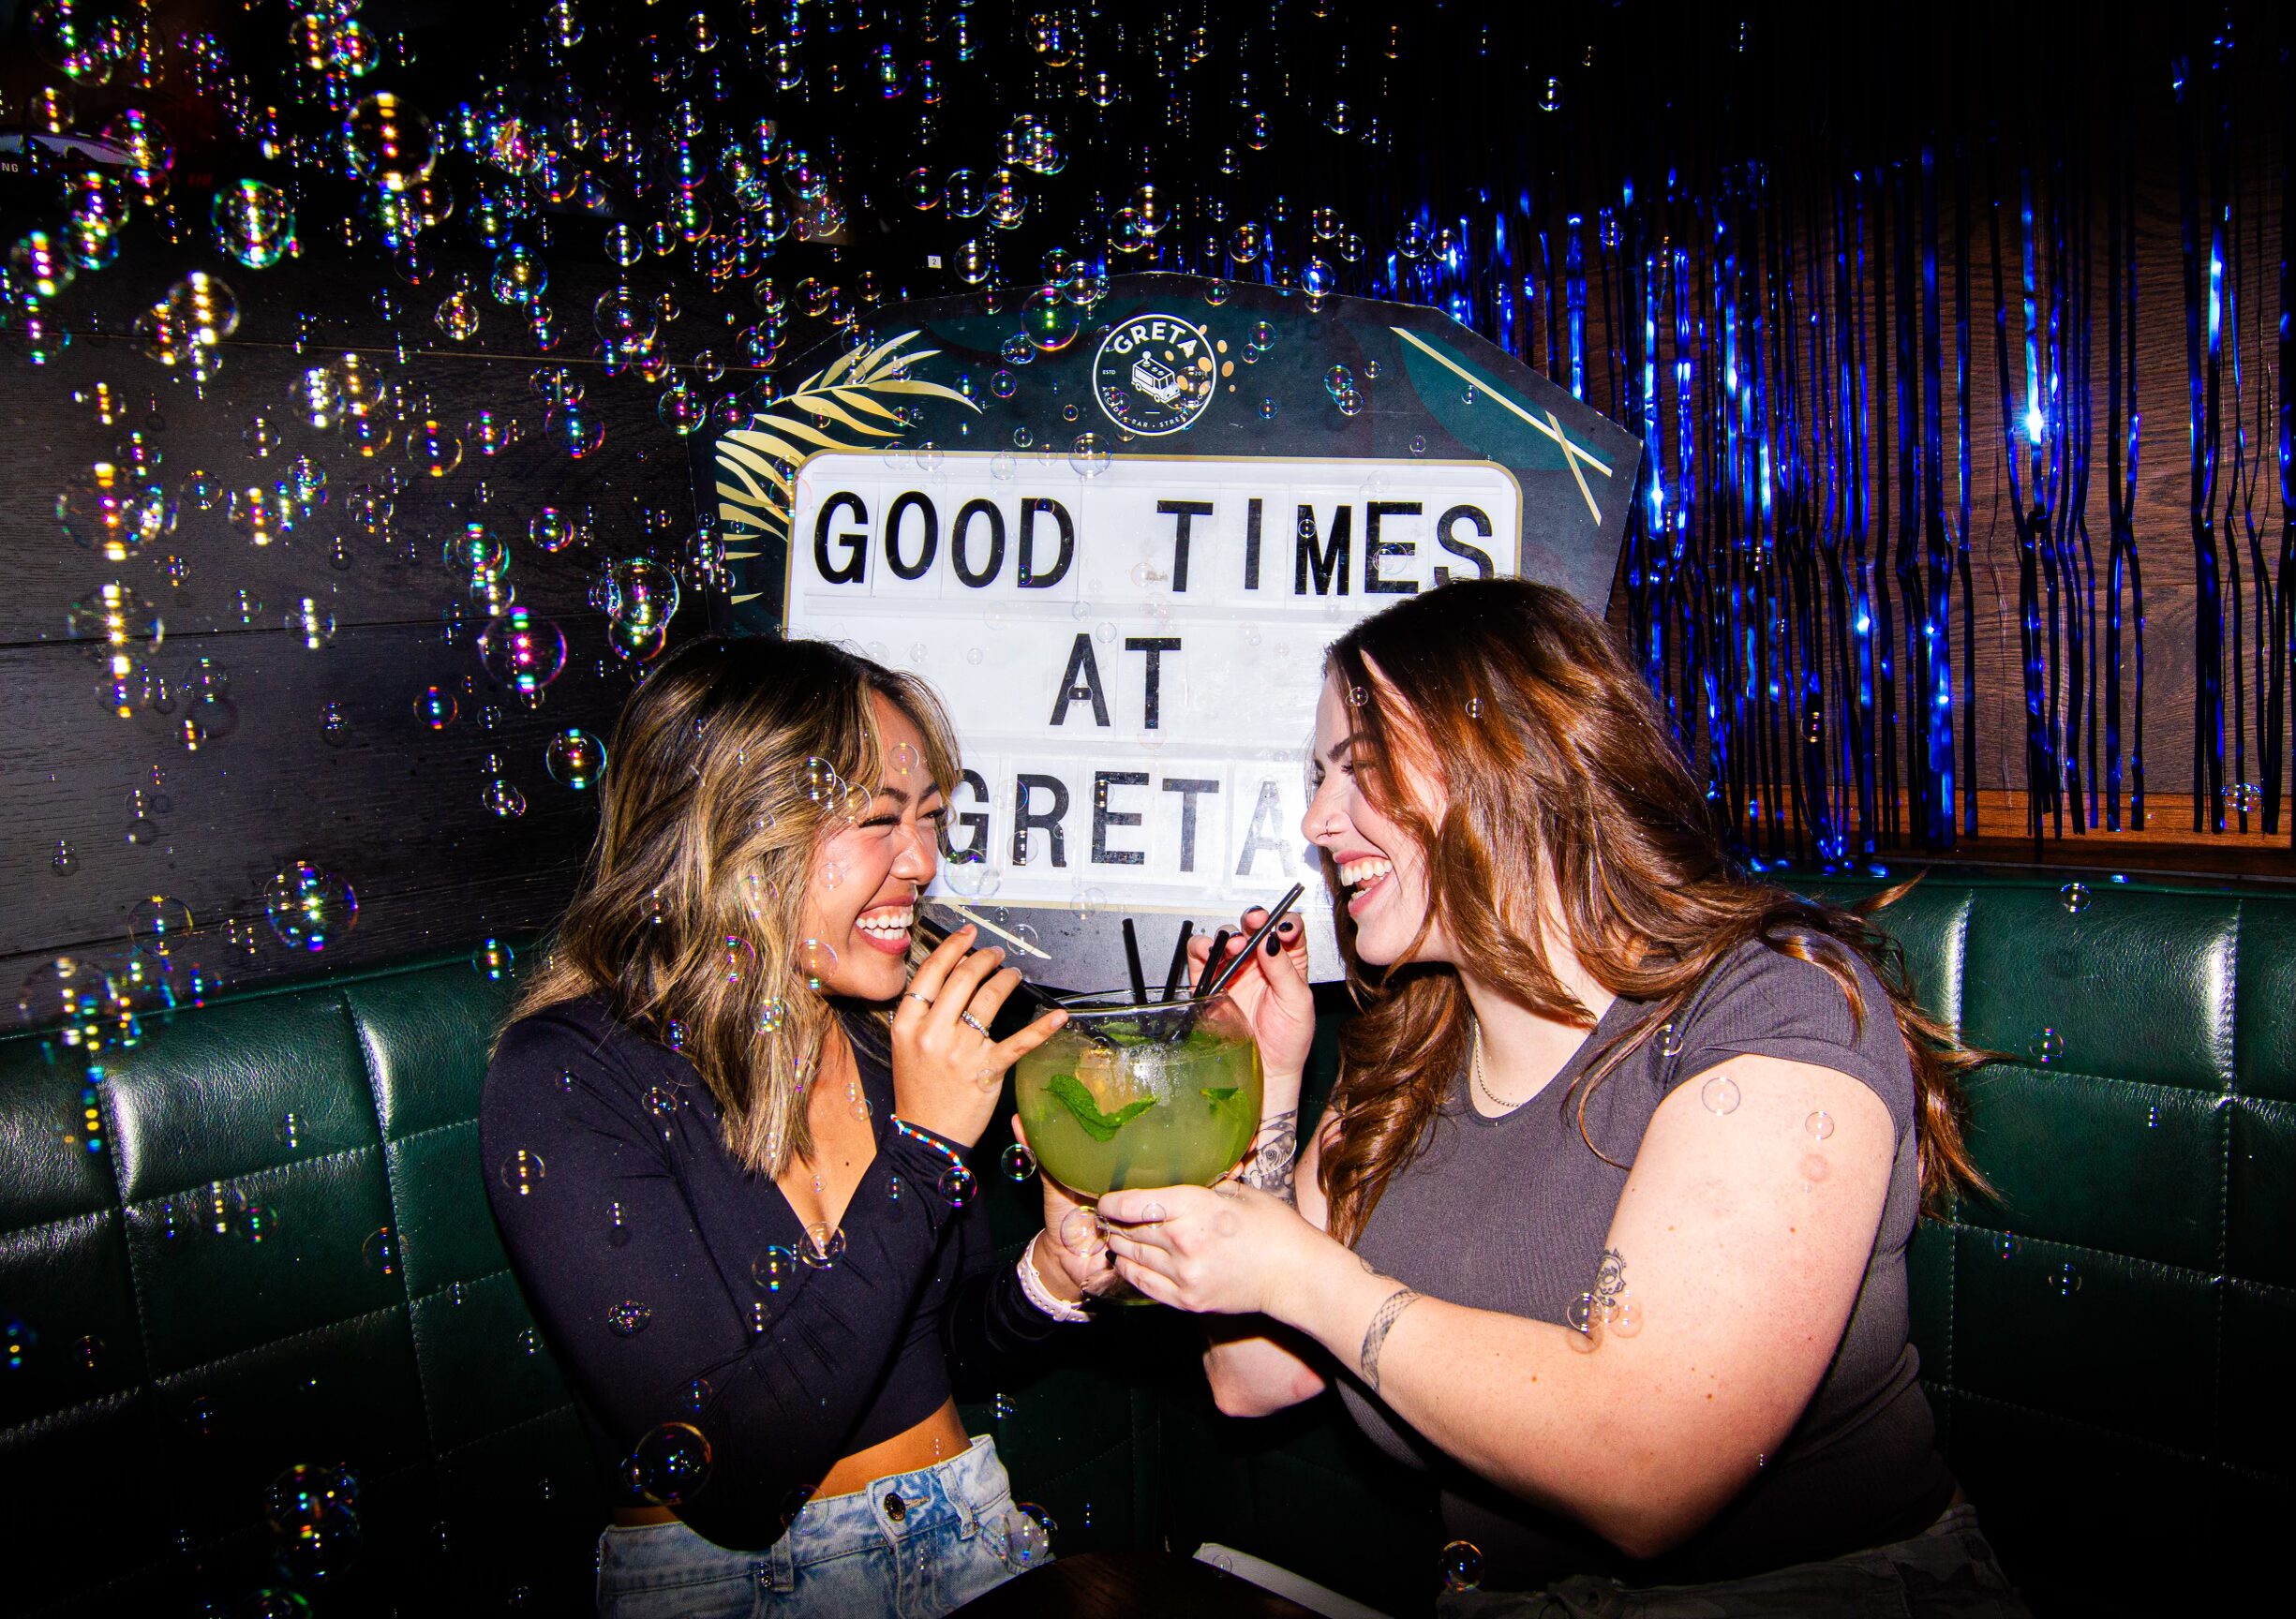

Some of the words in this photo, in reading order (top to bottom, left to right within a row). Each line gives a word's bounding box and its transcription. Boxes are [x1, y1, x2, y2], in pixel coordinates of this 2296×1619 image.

[1114, 321, 1198, 359] GRETA
[1131, 418, 1148, 428] BAR
[813, 491, 1076, 589] GOOD
[1156, 498, 1496, 595] TIMES
[1049, 633, 1183, 730] AT
[937, 768, 1299, 877] GRETA
